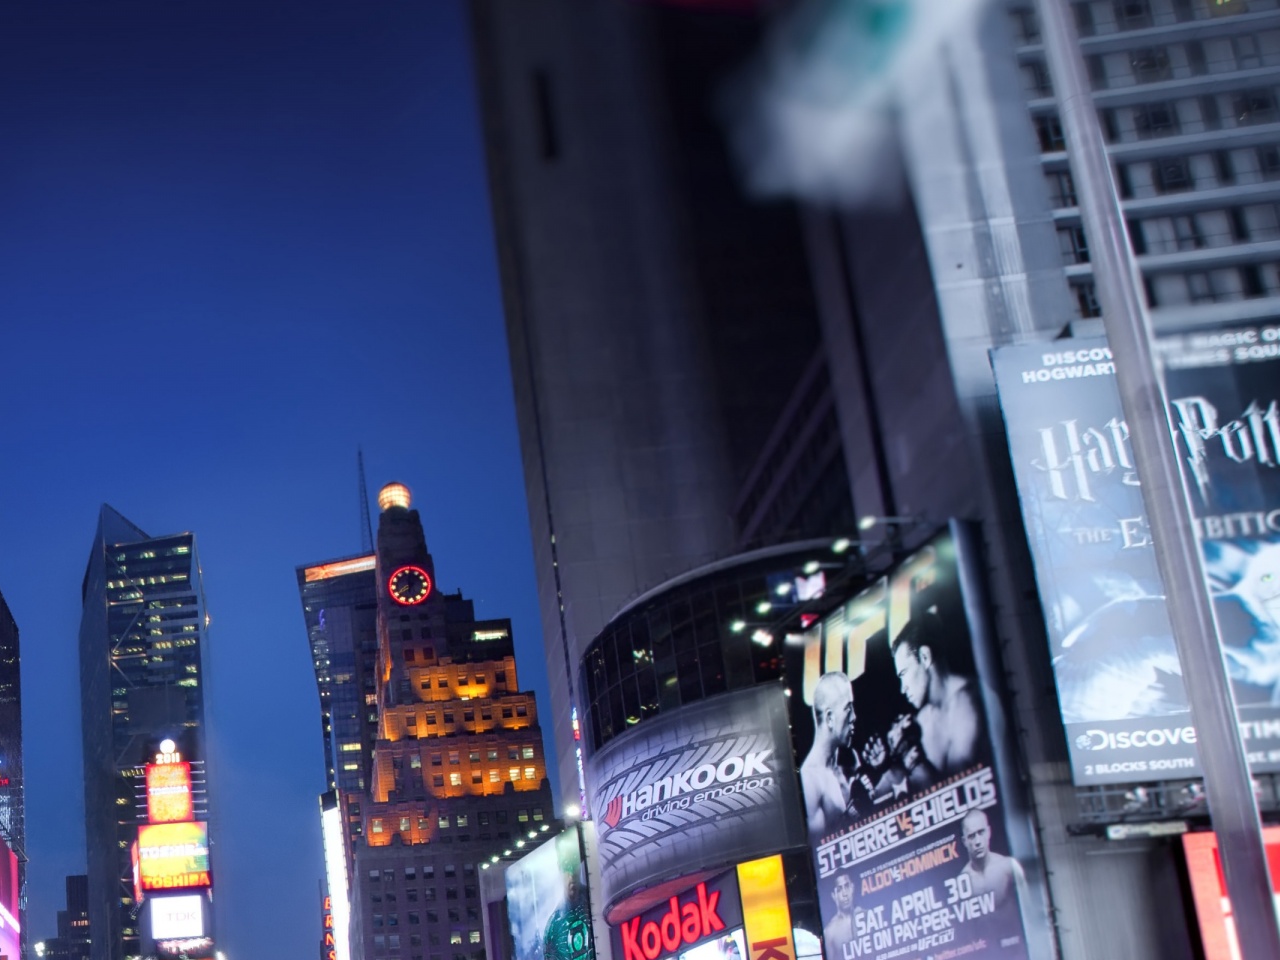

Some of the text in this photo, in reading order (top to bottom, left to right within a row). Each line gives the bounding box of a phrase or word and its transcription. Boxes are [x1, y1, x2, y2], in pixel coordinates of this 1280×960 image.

[1262, 328, 1280, 344] O
[1074, 529, 1111, 544] THE
[1096, 761, 1147, 774] BLOCKS
[1150, 758, 1195, 770] SOUTH
[641, 777, 773, 822] driving emotion
[817, 818, 900, 873] ST-PIERRE
[911, 771, 996, 833] SHIELDS
[899, 841, 959, 880] HOMINICK
[142, 872, 211, 890] TOSHIBA
[855, 873, 972, 937] SAT. APRIL 30
[843, 936, 872, 960] LIVE
[873, 928, 892, 950] ON
[893, 891, 995, 945] PAY-PER-VIEW
